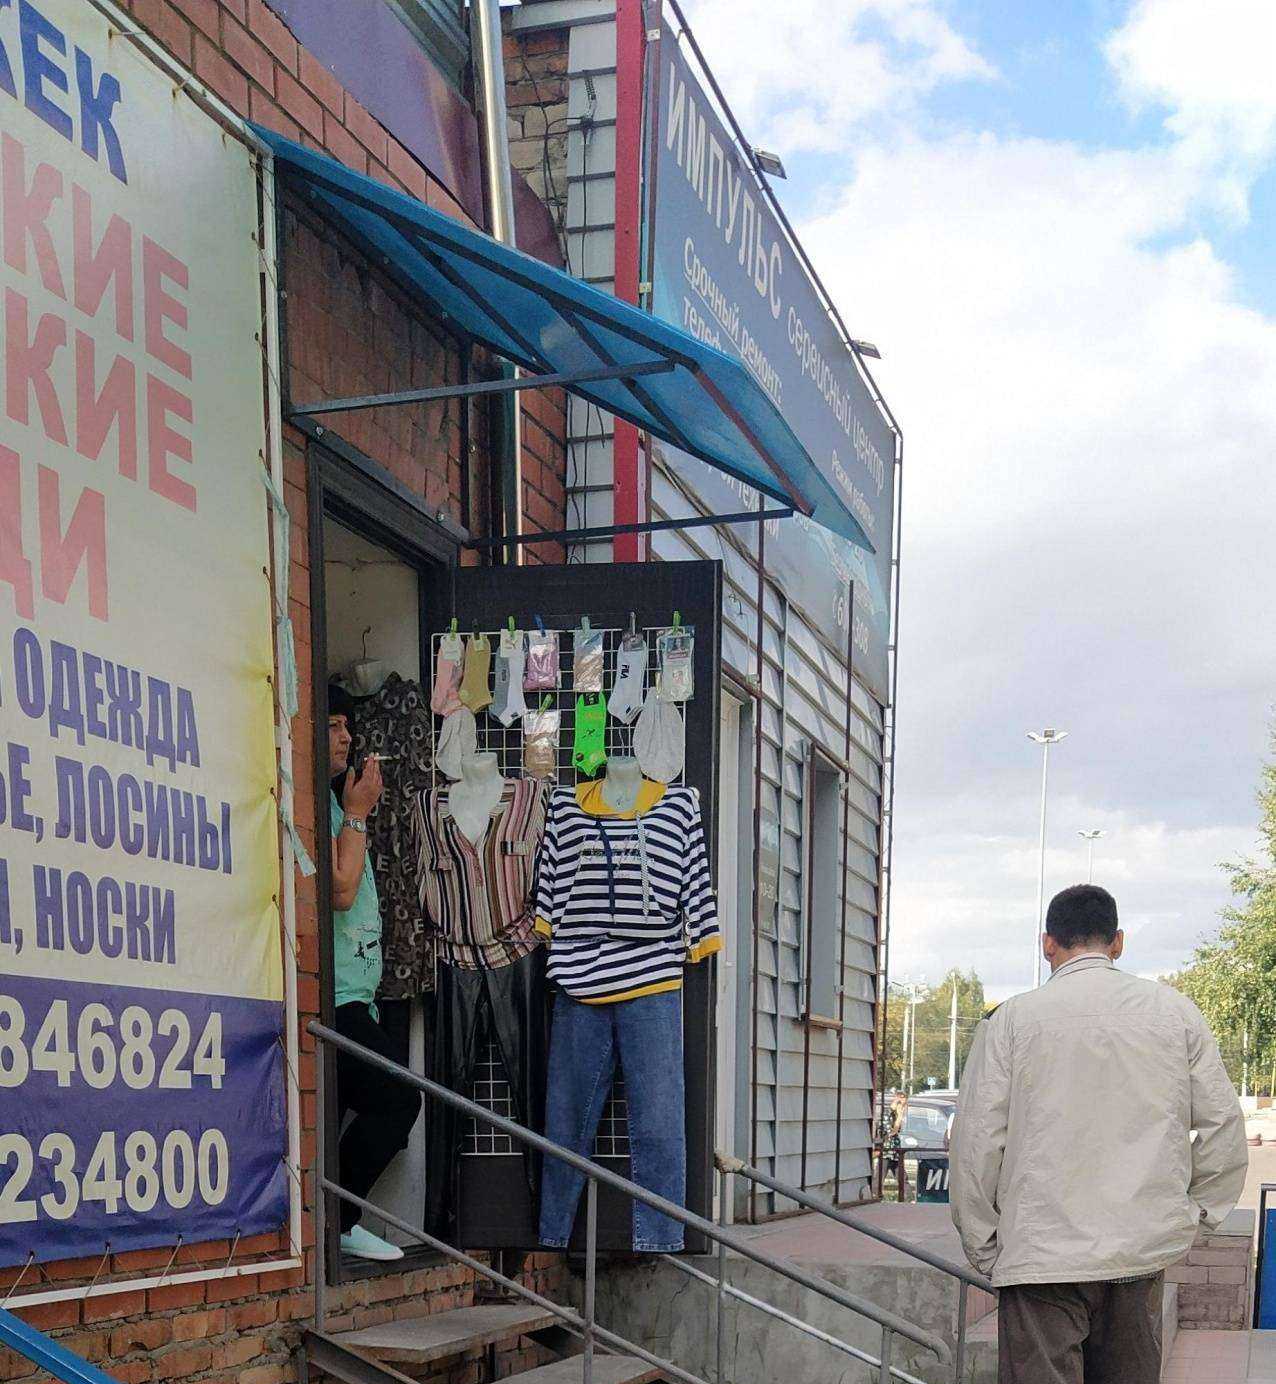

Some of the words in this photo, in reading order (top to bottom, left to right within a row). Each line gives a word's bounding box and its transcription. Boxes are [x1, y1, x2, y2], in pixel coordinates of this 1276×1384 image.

[1, 130, 192, 382] КИЕ
[666, 62, 783, 320] ИМПУЛЬС
[787, 306, 852, 435] сервисный
[852, 416, 885, 497] центр
[684, 236, 740, 342] Срочный
[4, 284, 197, 514] КИЕ
[13, 626, 201, 775] ОДЕЖДА
[620, 664, 630, 680] FILA
[54, 755, 232, 874] ЛОСИНЫ
[32, 863, 177, 965] НОСКИ
[0, 994, 226, 1089] 846824
[0, 1128, 229, 1223] 234800
